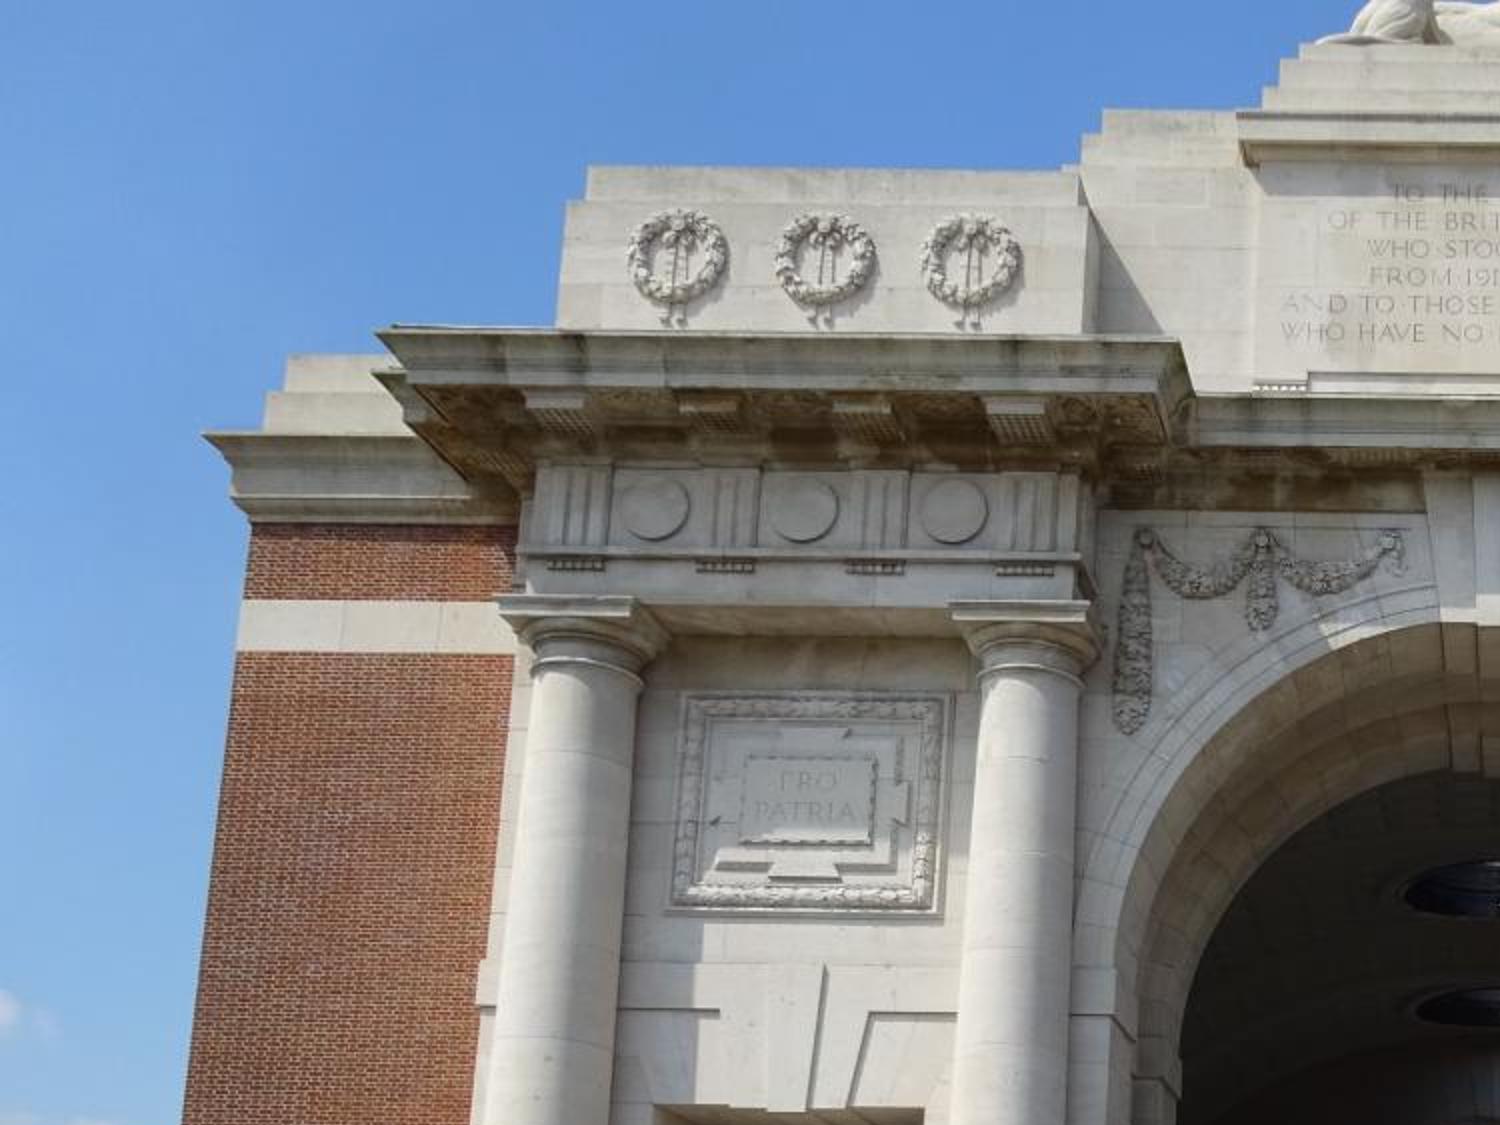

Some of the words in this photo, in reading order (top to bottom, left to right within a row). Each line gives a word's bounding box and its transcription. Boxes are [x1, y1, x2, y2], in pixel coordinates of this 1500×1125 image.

[1391, 183, 1425, 203] TO
[1439, 183, 1488, 205] THE
[1328, 210, 1360, 231] OF
[1375, 211, 1426, 232] THE
[1367, 239, 1430, 259] WHO
[1370, 266, 1451, 287] FROM
[1282, 293, 1348, 314] AND
[1360, 294, 1395, 315] TO
[1408, 294, 1494, 316] THOSE
[1281, 322, 1346, 343] WHO
[1358, 323, 1426, 343] HAVE
[1442, 324, 1484, 343] NO
[780, 769, 838, 792] PRO
[755, 801, 856, 823] PATRIA
